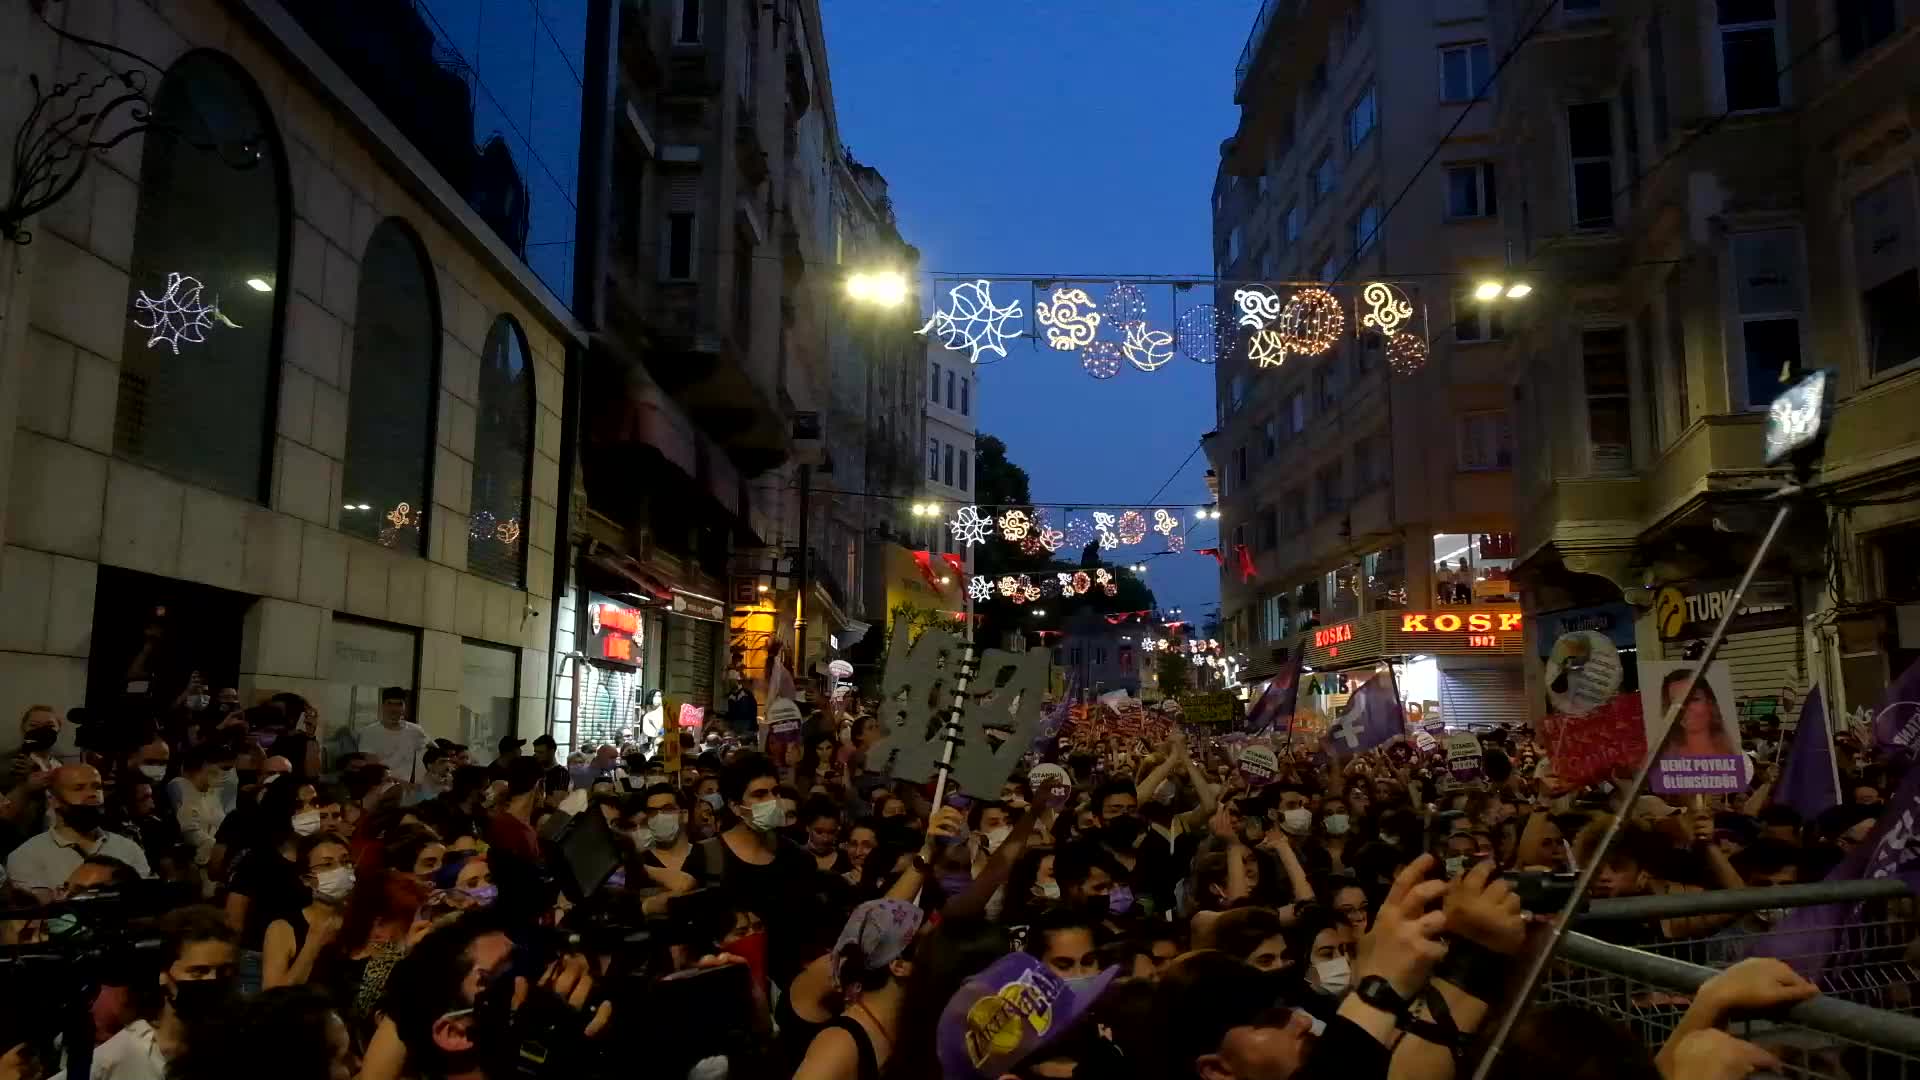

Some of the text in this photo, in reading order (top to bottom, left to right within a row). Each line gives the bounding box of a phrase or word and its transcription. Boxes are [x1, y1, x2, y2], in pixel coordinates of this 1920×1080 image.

[1686, 589, 1784, 623] TURK
[1315, 624, 1352, 648] KOSKA
[1469, 635, 1496, 647] 1907
